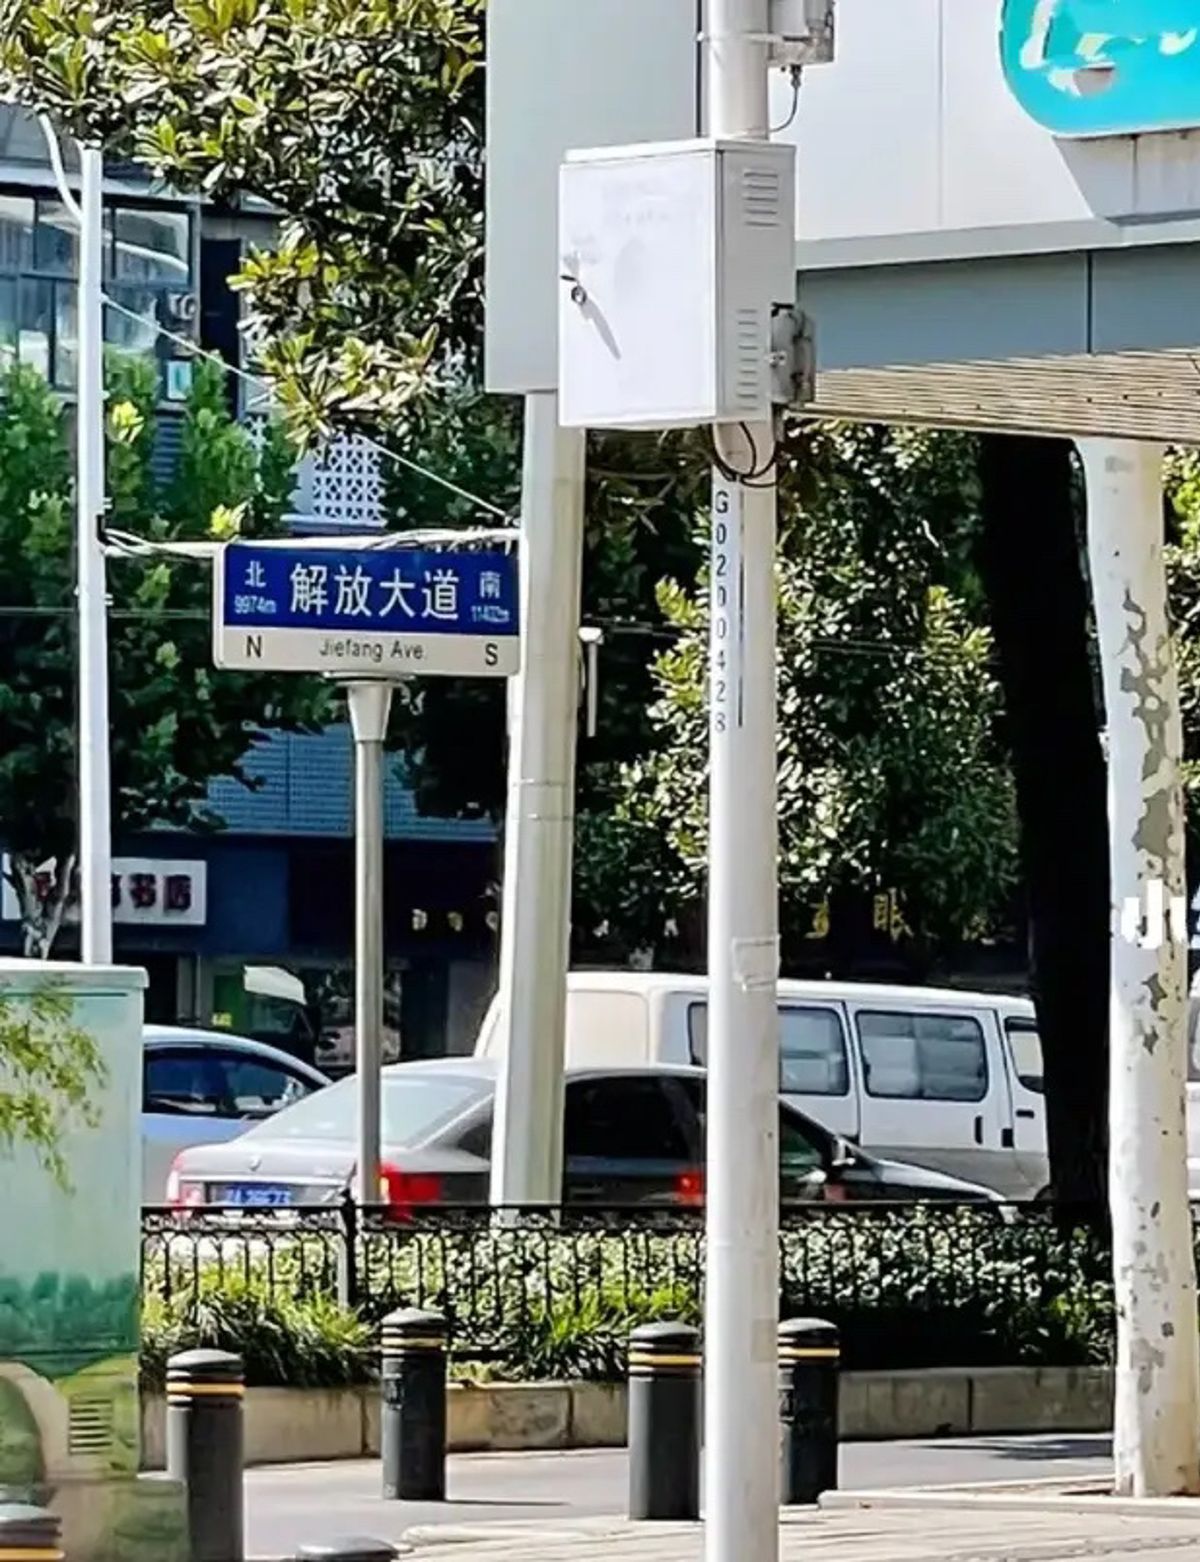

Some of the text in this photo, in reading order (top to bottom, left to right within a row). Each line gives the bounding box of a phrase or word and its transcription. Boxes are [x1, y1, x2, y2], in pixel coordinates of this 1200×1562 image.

[244, 560, 267, 588] 北
[479, 571, 501, 599] 南
[288, 562, 460, 621] 解放大道
[246, 635, 263, 658] N
[319, 639, 384, 664] Jiefang
[484, 643, 499, 667] S
